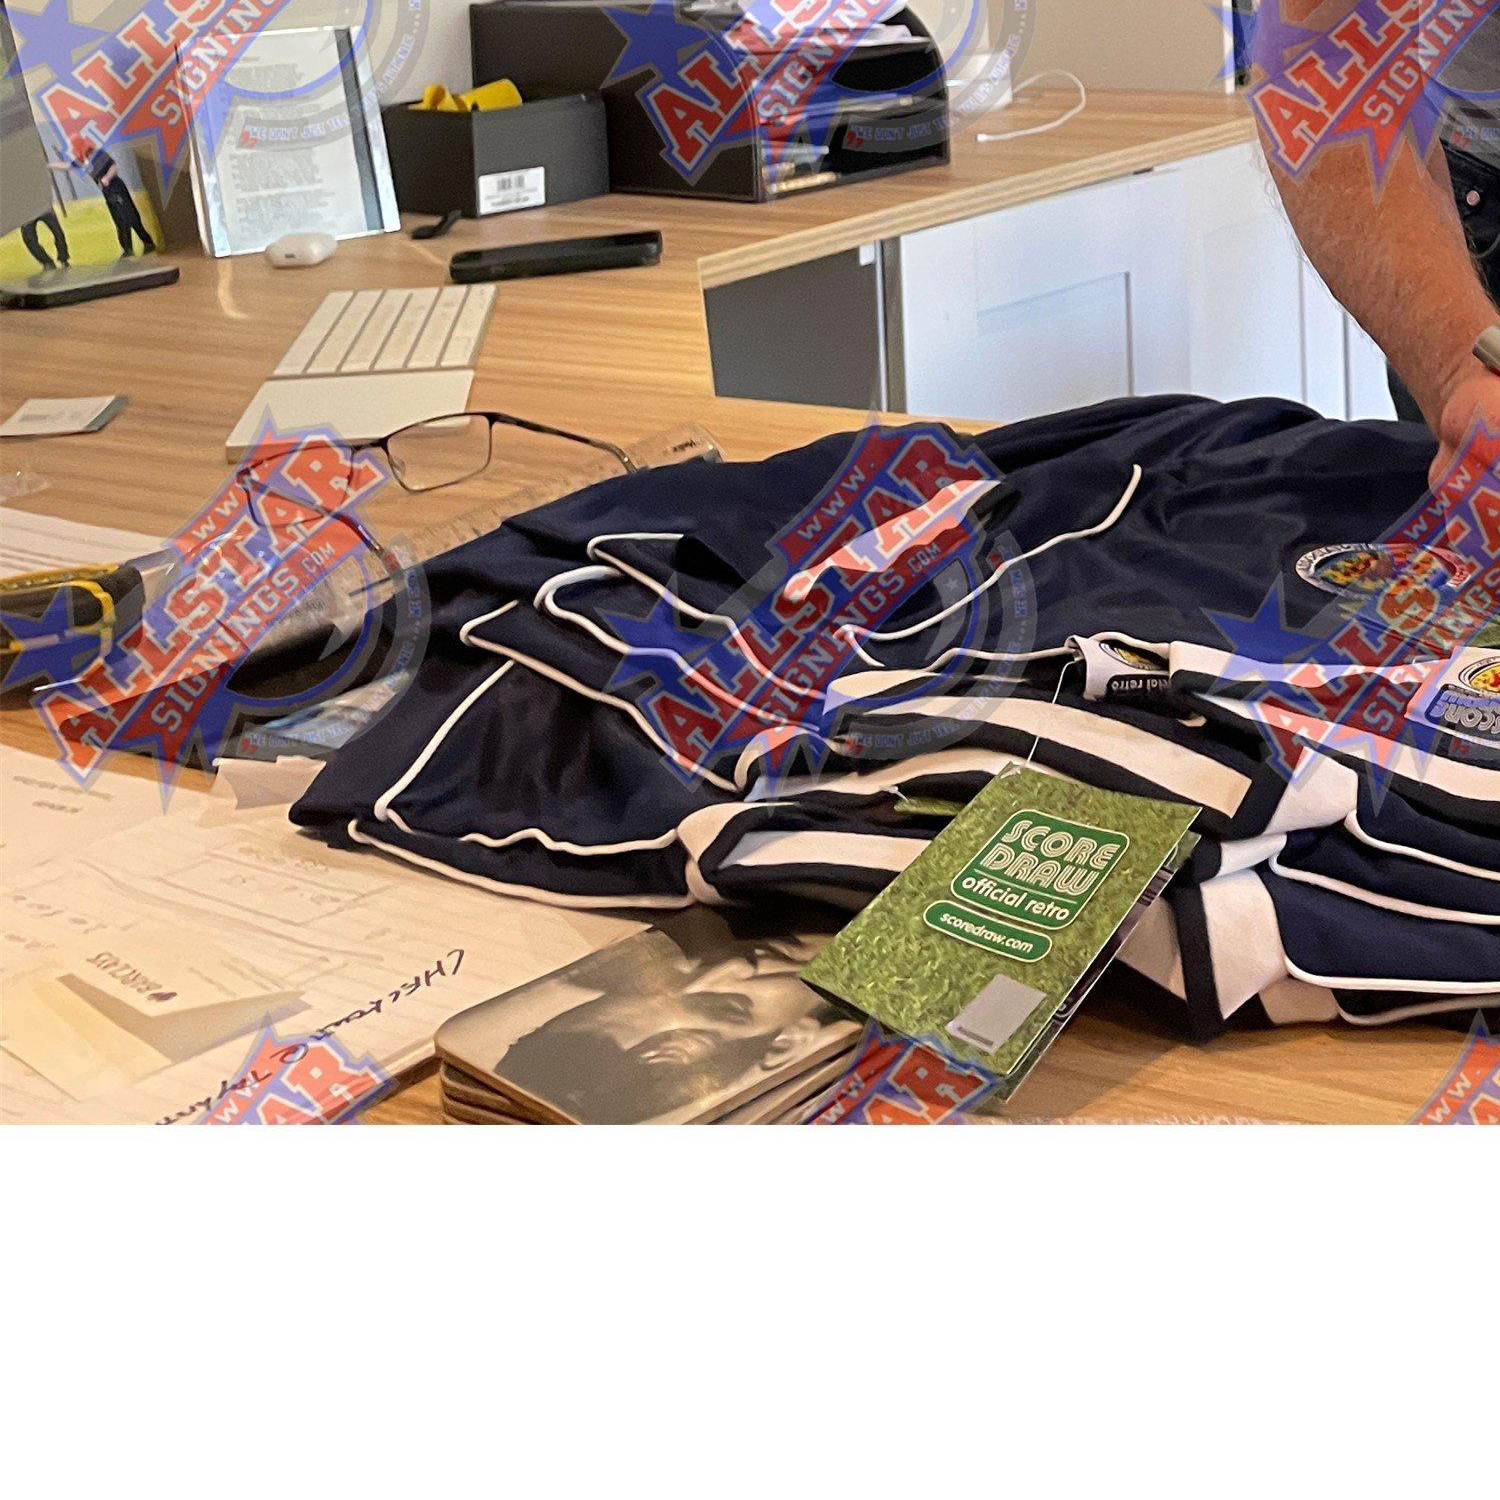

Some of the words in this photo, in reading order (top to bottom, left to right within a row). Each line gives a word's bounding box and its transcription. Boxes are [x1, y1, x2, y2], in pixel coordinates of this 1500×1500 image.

[1001, 820, 1120, 869] SCORE
[980, 843, 1100, 896] DRAW
[962, 876, 1027, 907] official
[1025, 901, 1069, 921] retro
[939, 911, 1033, 953] scoredraw.com
